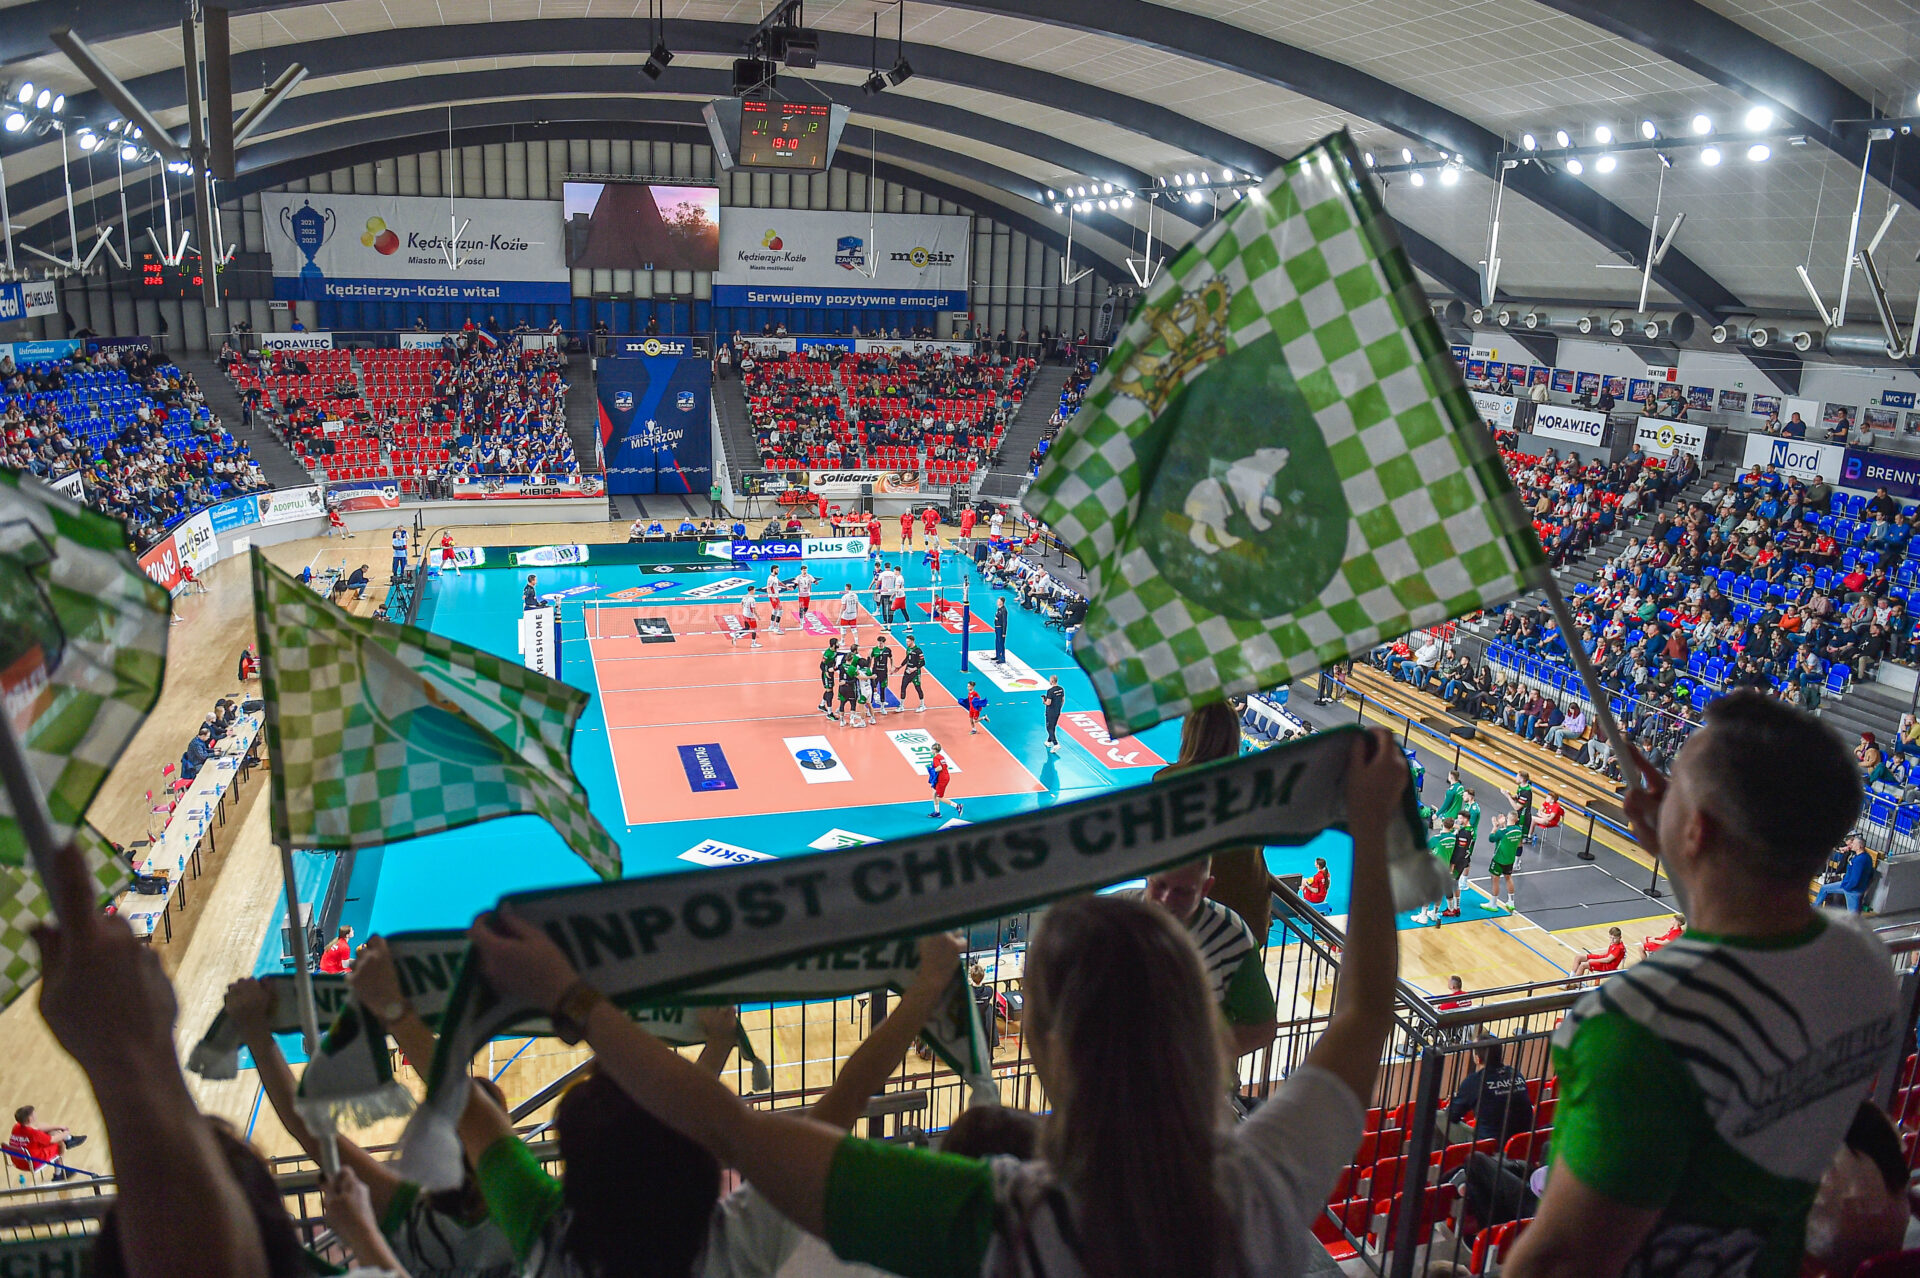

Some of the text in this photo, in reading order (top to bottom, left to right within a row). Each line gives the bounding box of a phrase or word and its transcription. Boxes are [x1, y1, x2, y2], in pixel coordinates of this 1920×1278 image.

[757, 119, 768, 130] 11
[782, 122, 789, 132] 3
[807, 122, 818, 133] 12
[772, 137, 799, 150] 19:10
[408, 257, 437, 265] Miasto
[738, 250, 807, 263] Kędzierzyn-Koźle
[891, 247, 954, 267] mosir
[326, 284, 500, 298] Kędzierzyn-Koźle wita!
[747, 291, 949, 307] Serwujemy pozytywne emocje!
[264, 339, 330, 350] MORAWIEC
[626, 338, 685, 356] mosir
[1885, 395, 1900, 403] WC
[1537, 413, 1601, 437] MORAWIEC
[631, 428, 684, 450] MISTRZÓW
[1639, 424, 1700, 449] mosir
[1771, 444, 1820, 471] Nord
[814, 473, 879, 486] Solidaris
[520, 487, 561, 496] KIBICA
[273, 500, 307, 513] ADOPTUJ!
[179, 527, 210, 560] mosir
[734, 543, 800, 555] ZAKSA
[808, 542, 843, 554] plus
[535, 613, 544, 673] KRISHOME
[1066, 713, 1120, 746] ORLEN
[693, 746, 717, 779] BRENNTAG
[544, 762, 1309, 968] INPOST CHKS CHEŁM
